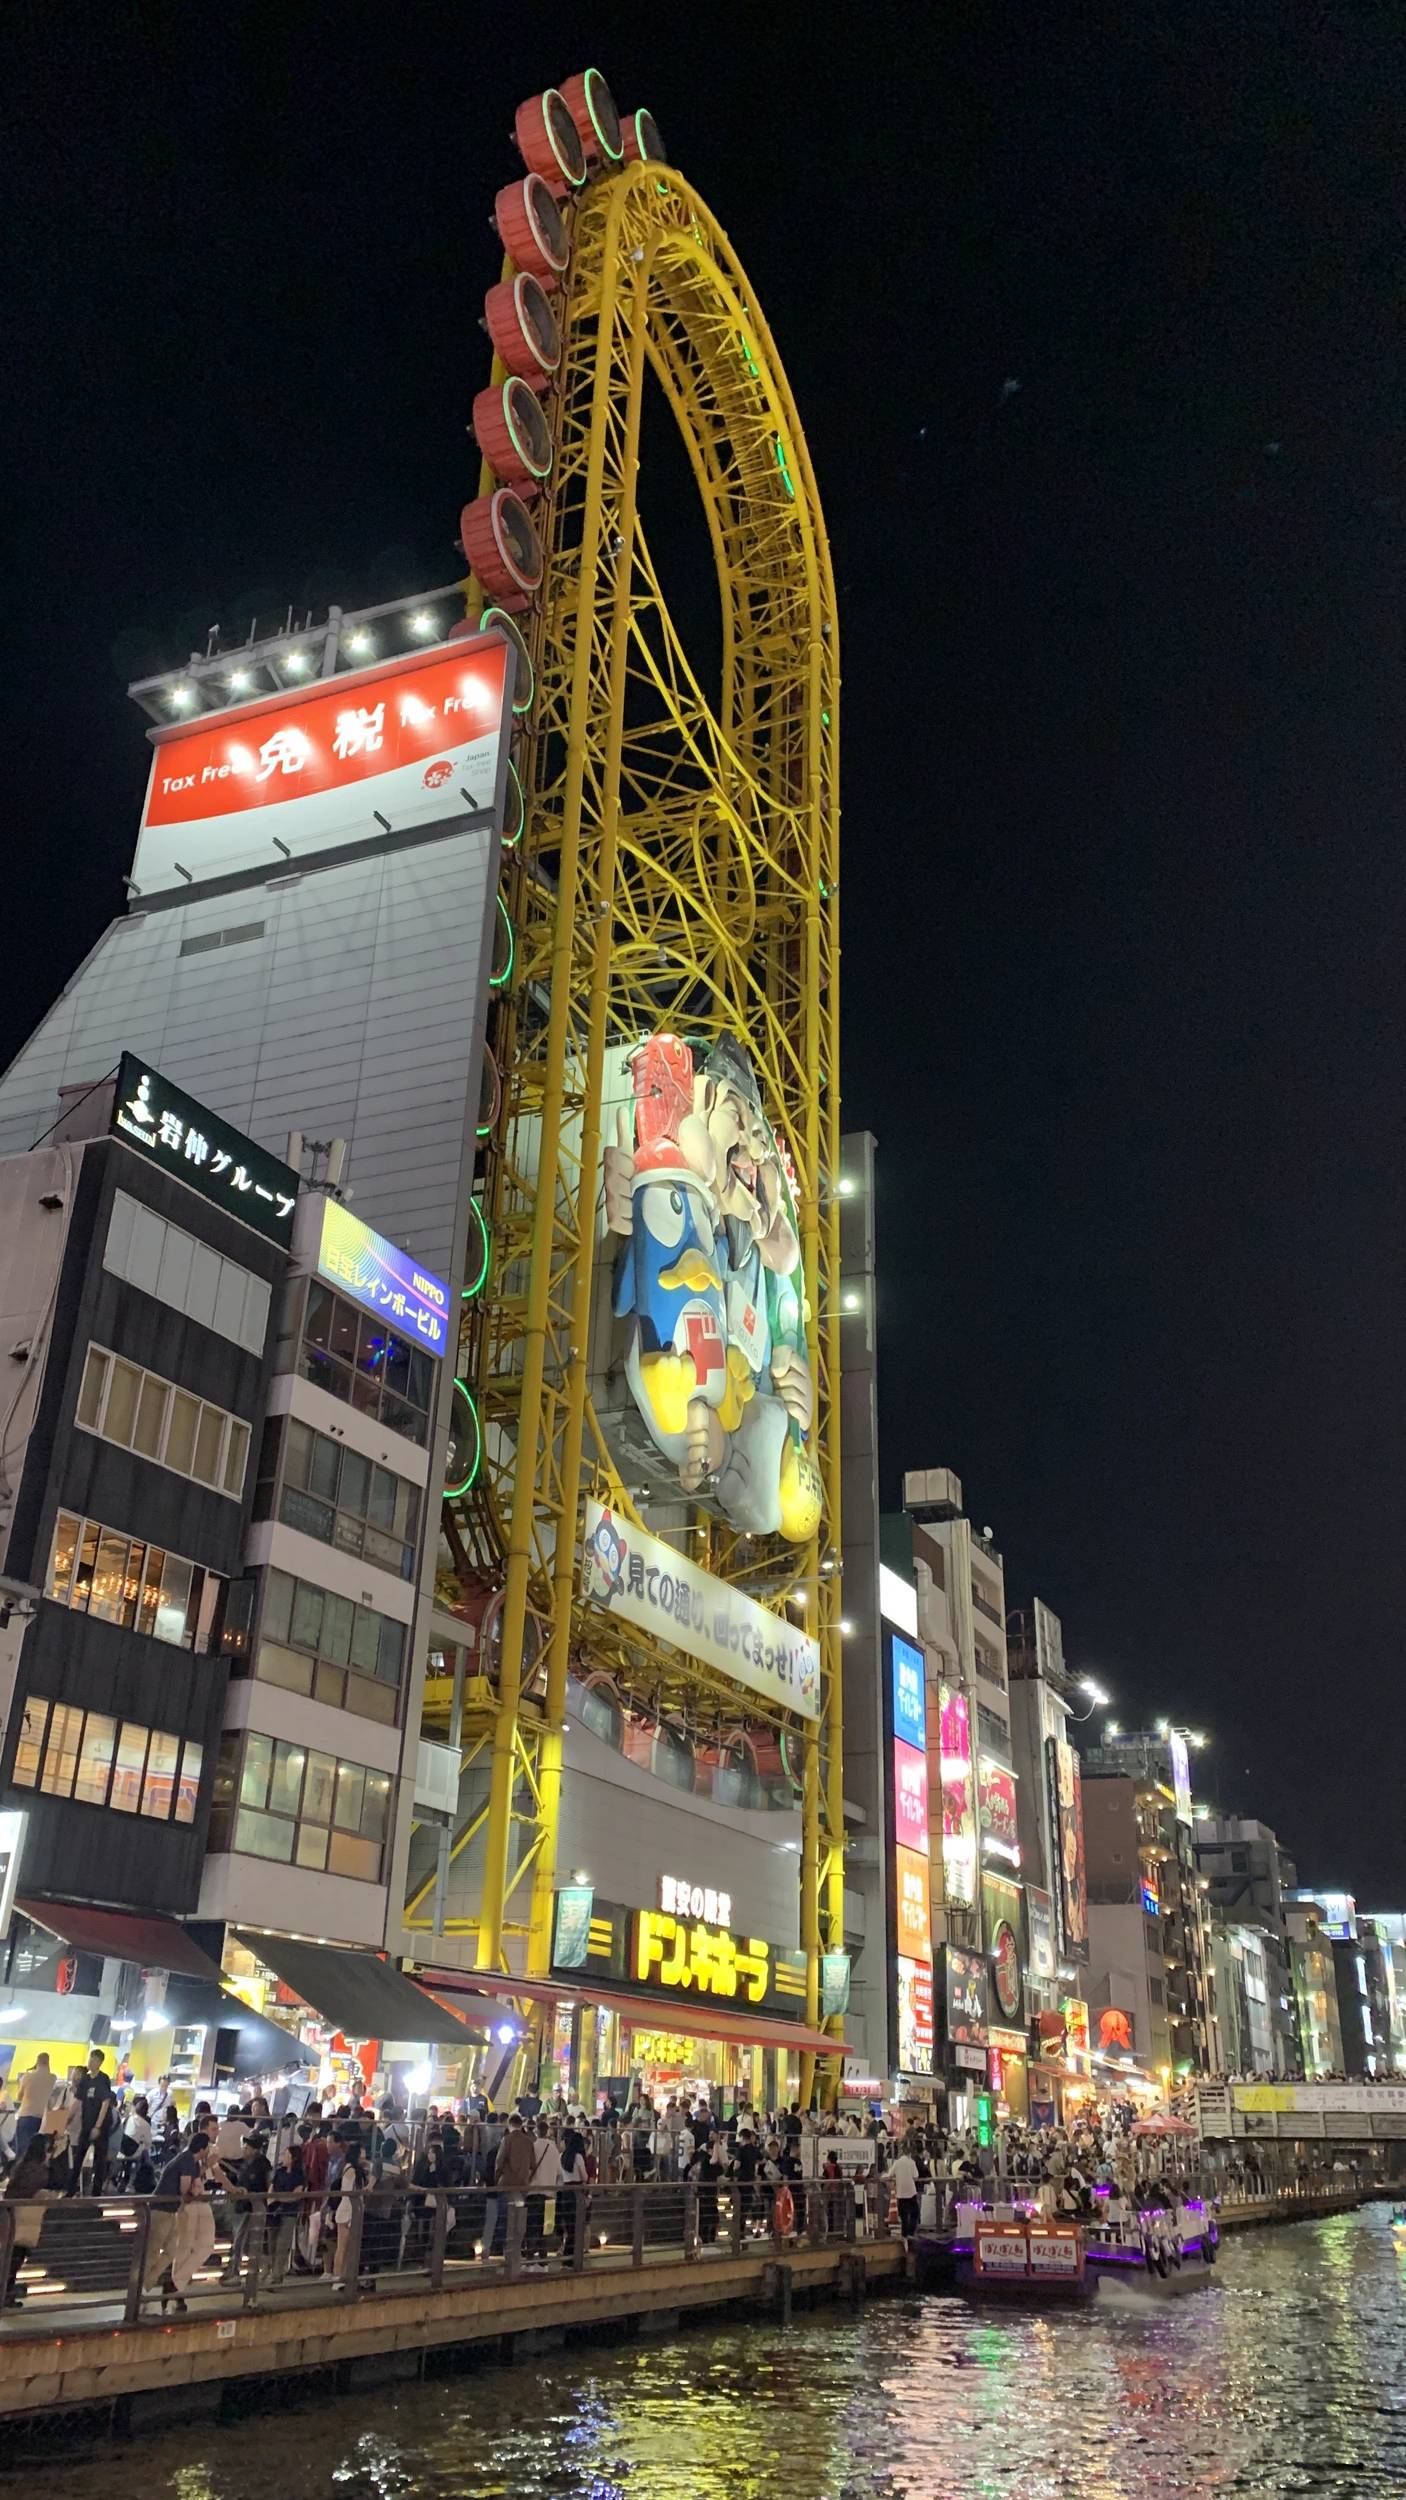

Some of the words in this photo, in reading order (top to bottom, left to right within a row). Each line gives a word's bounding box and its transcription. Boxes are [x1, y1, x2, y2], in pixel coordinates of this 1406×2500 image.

[401, 705, 437, 727] Tx
[256, 703, 385, 783] 免税
[163, 774, 196, 795] Tax
[158, 1110, 296, 1218] 岩伸グループ
[413, 1272, 444, 1305] NIPPO
[661, 1875, 732, 1927] 安の堂
